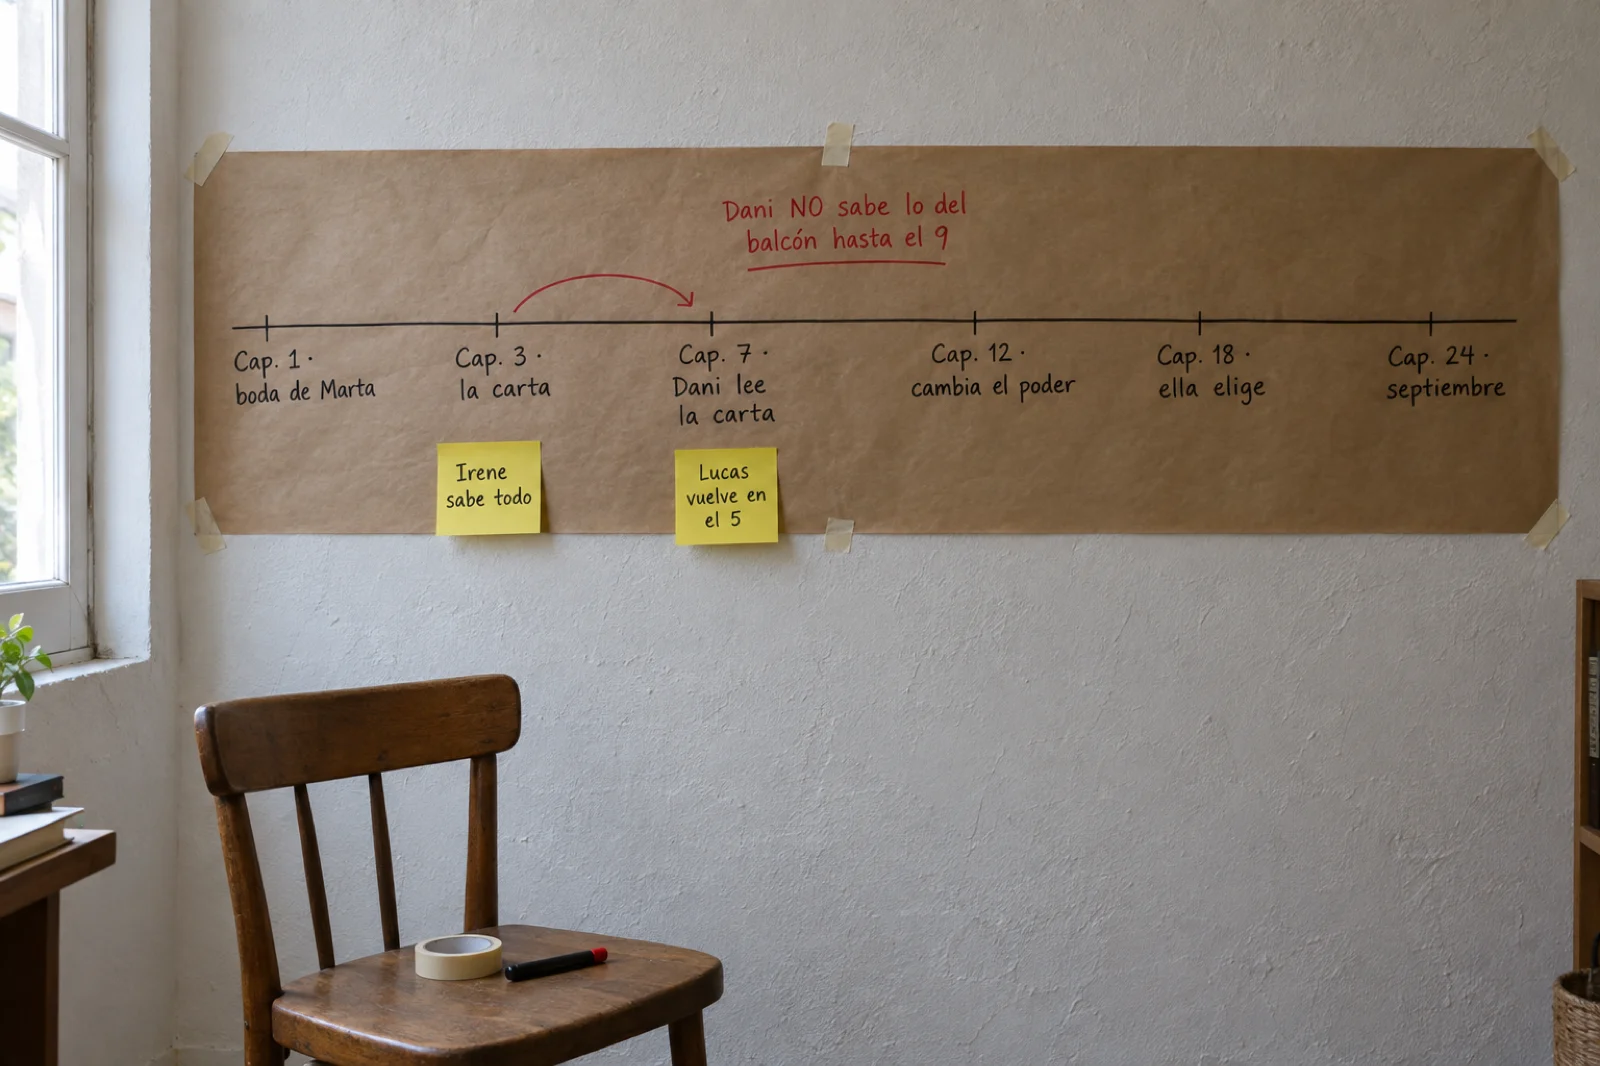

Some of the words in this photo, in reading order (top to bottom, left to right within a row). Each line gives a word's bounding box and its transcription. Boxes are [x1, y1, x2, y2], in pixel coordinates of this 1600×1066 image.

[722, 199, 774, 222] Dani
[790, 195, 823, 218] NO
[838, 193, 890, 217] sabe
[905, 192, 924, 215] lo
[934, 190, 967, 215] del
[747, 228, 818, 253] balcón
[832, 226, 893, 249] hasta
[905, 225, 923, 248] el
[934, 225, 949, 250] 9
[233, 350, 279, 378] Cap.
[288, 348, 301, 370] 1
[455, 346, 503, 376] Cap.
[513, 345, 527, 367] 3
[678, 343, 726, 372] Cap.
[736, 343, 752, 364] 7
[931, 343, 978, 372] Cap.
[988, 343, 1013, 363] 12
[1157, 343, 1203, 373] Cap.
[1212, 343, 1235, 365] 18
[1388, 345, 1435, 373] Cap.
[1445, 345, 1475, 366] 24
[235, 382, 281, 405] boda
[289, 379, 311, 402] de
[320, 377, 376, 401] Marta
[460, 378, 480, 401] la
[492, 377, 551, 399] carta
[672, 376, 721, 398] Dani
[736, 373, 767, 395] lee
[911, 375, 982, 398] cambia
[992, 374, 1008, 396] el
[1019, 374, 1076, 404] poder
[1158, 376, 1199, 399] ella
[1213, 374, 1266, 406] elige
[1386, 376, 1506, 407] septiembre
[679, 404, 699, 427] la
[712, 404, 776, 424] carta
[455, 462, 508, 483] Irene
[699, 463, 749, 482] Lucas
[446, 488, 486, 509] sabe
[493, 487, 532, 507] todo
[686, 486, 739, 507] vuelve
[746, 490, 767, 503] en
[704, 510, 720, 529] el
[730, 509, 742, 527] 5
